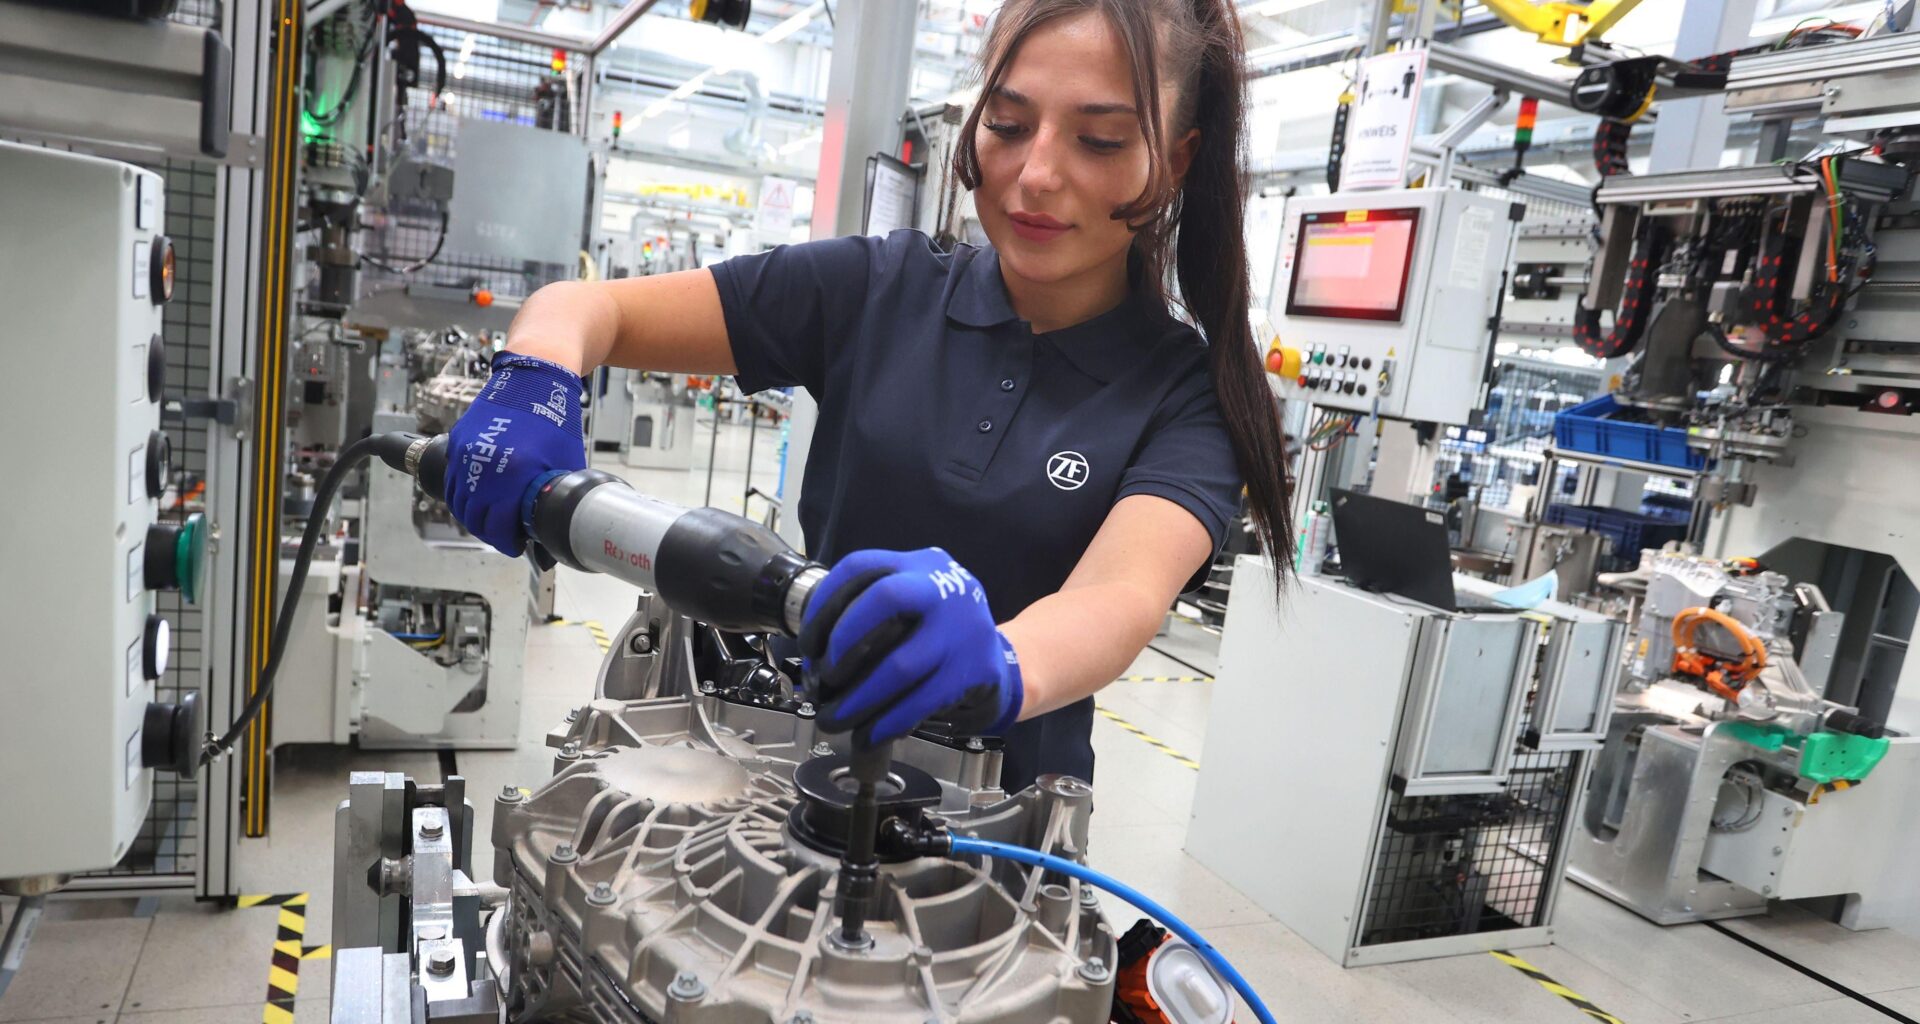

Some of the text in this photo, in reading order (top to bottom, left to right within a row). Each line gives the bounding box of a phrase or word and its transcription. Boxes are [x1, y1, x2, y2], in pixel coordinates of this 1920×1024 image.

[532, 404, 565, 427] Ansell
[466, 417, 512, 489] HyFlex
[1049, 454, 1088, 486] ZF
